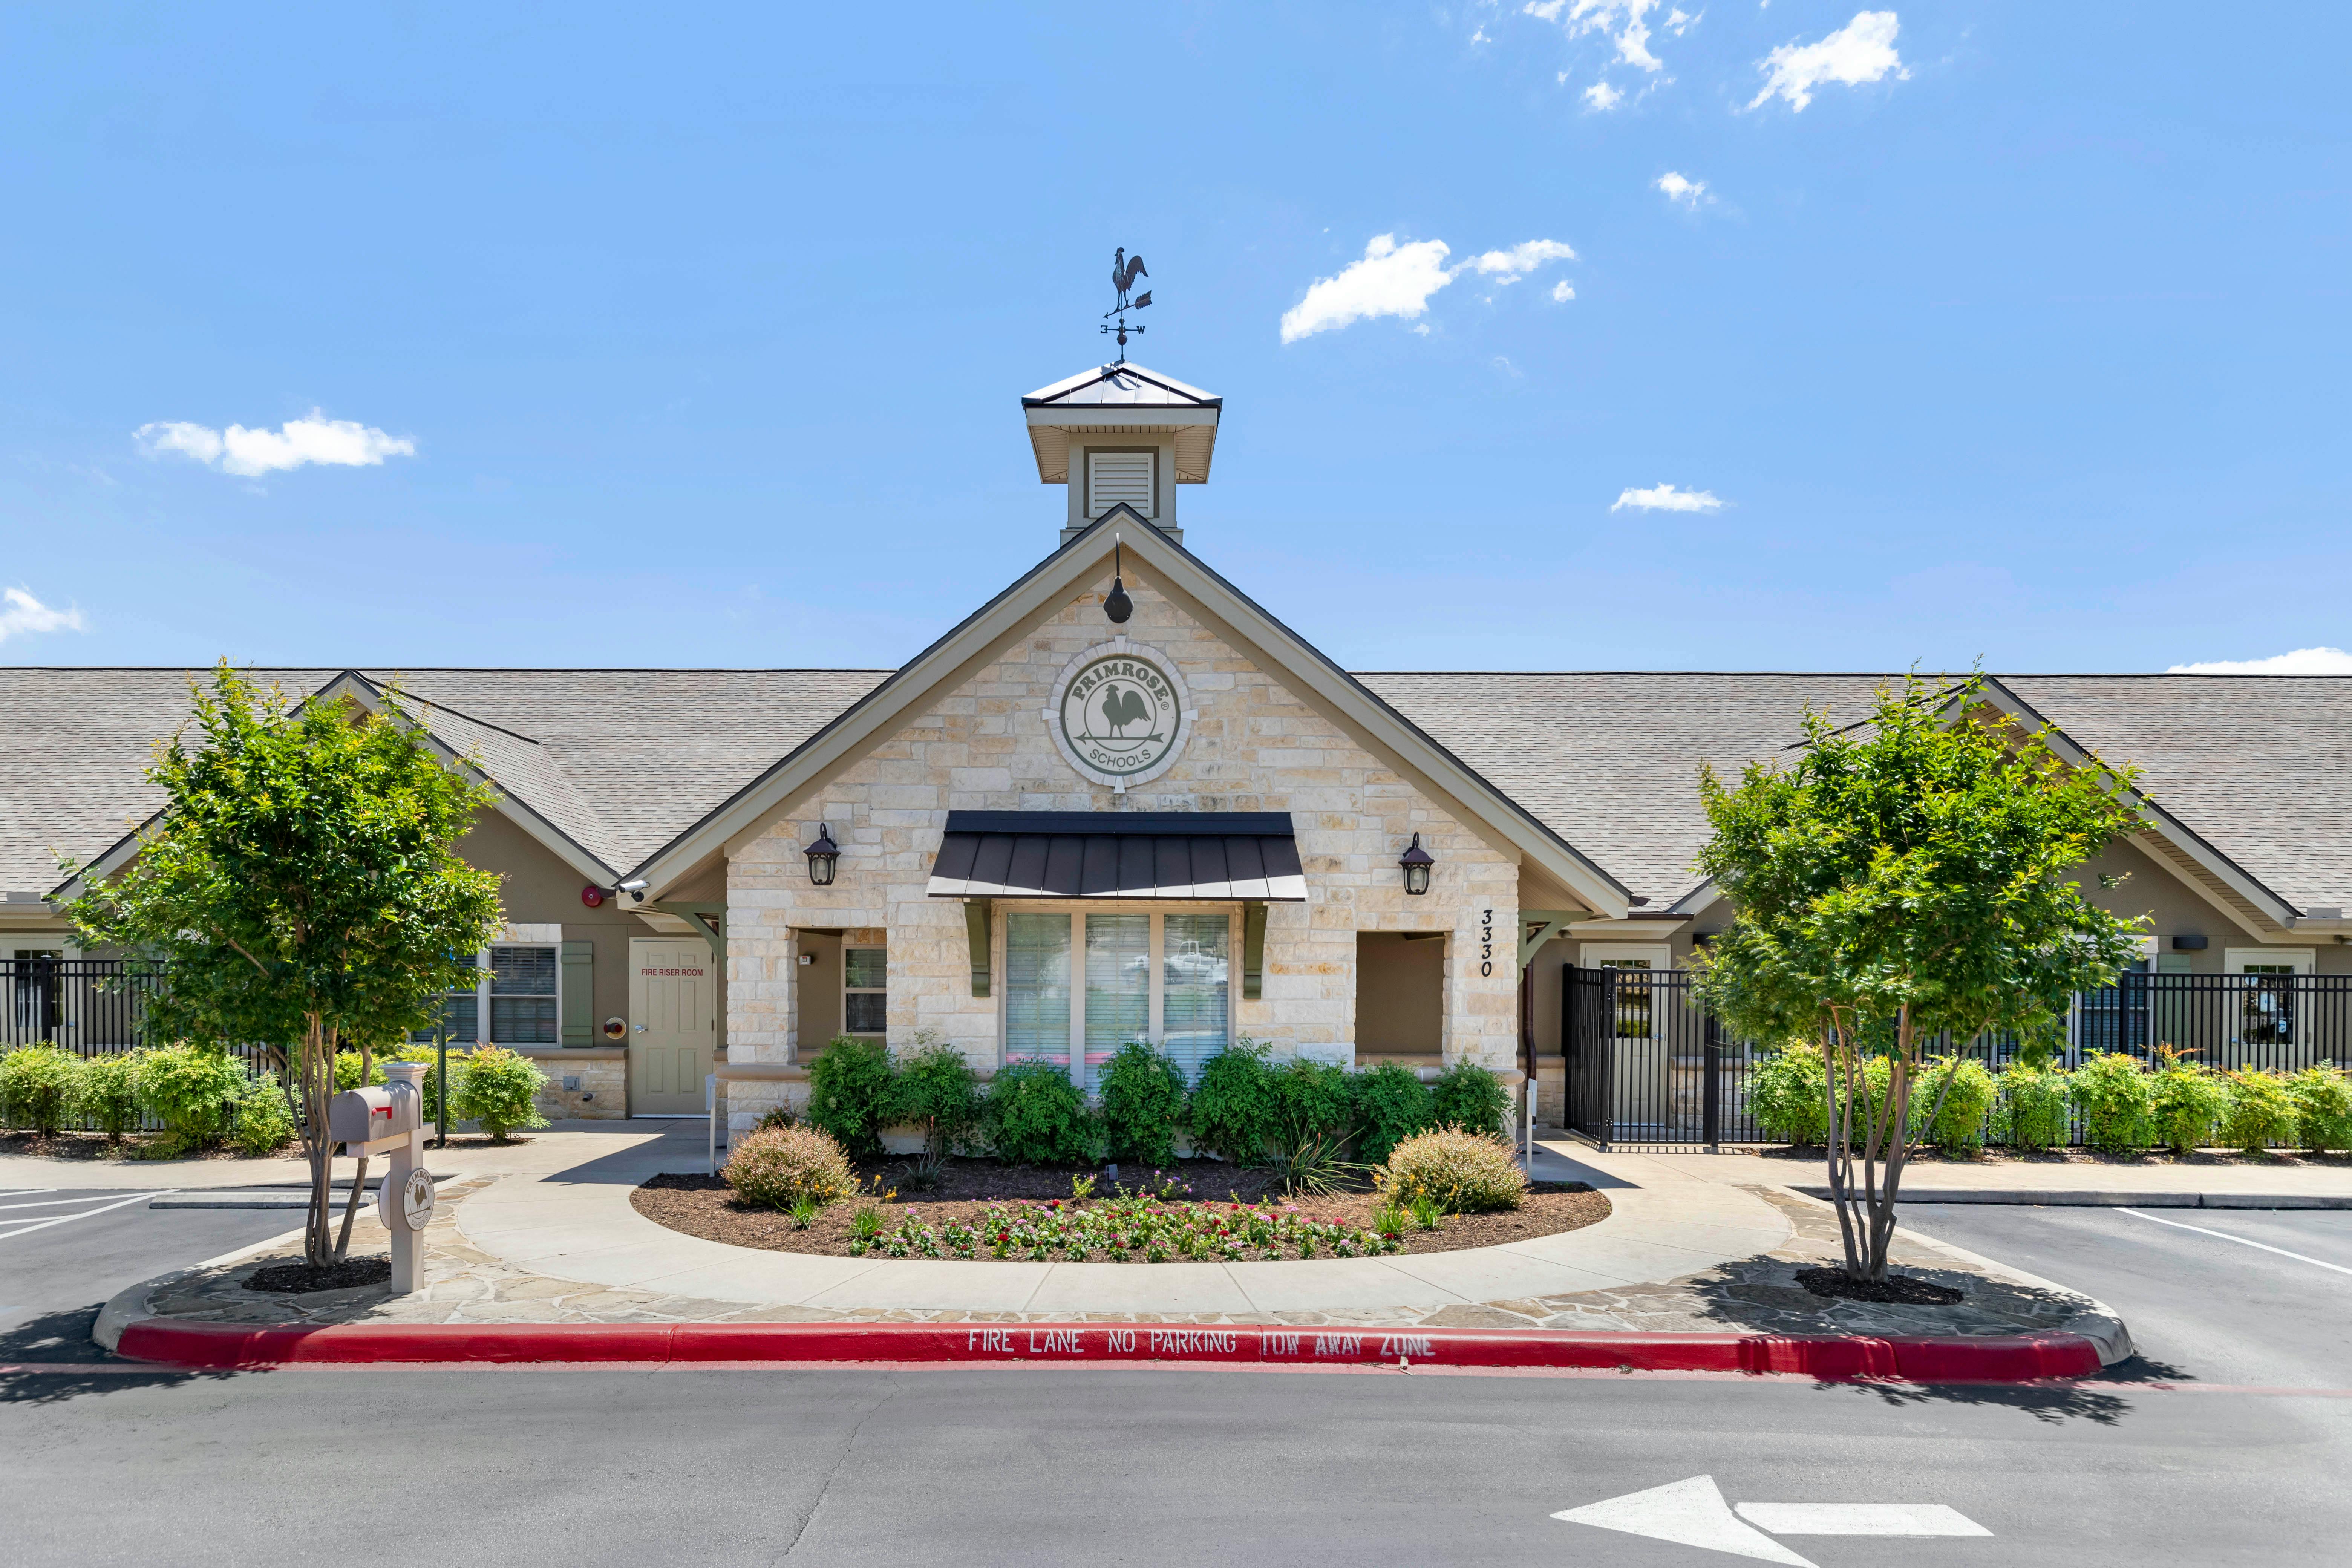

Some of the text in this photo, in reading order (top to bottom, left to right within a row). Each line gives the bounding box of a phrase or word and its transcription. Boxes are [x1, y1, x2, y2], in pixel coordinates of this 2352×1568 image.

[1136, 326, 1146, 334] W
[1090, 749, 1151, 767] SCHOOLS
[1481, 910, 1493, 977] 3330
[411, 1215, 429, 1228] SCHOOLS
[969, 1329, 1014, 1352] FIRE
[1029, 1329, 1084, 1353] LANE
[1108, 1329, 1135, 1353] NO
[1150, 1330, 1236, 1353] PARKING
[1315, 1332, 1363, 1356] AWAY
[1380, 1334, 1436, 1357] ZONE
